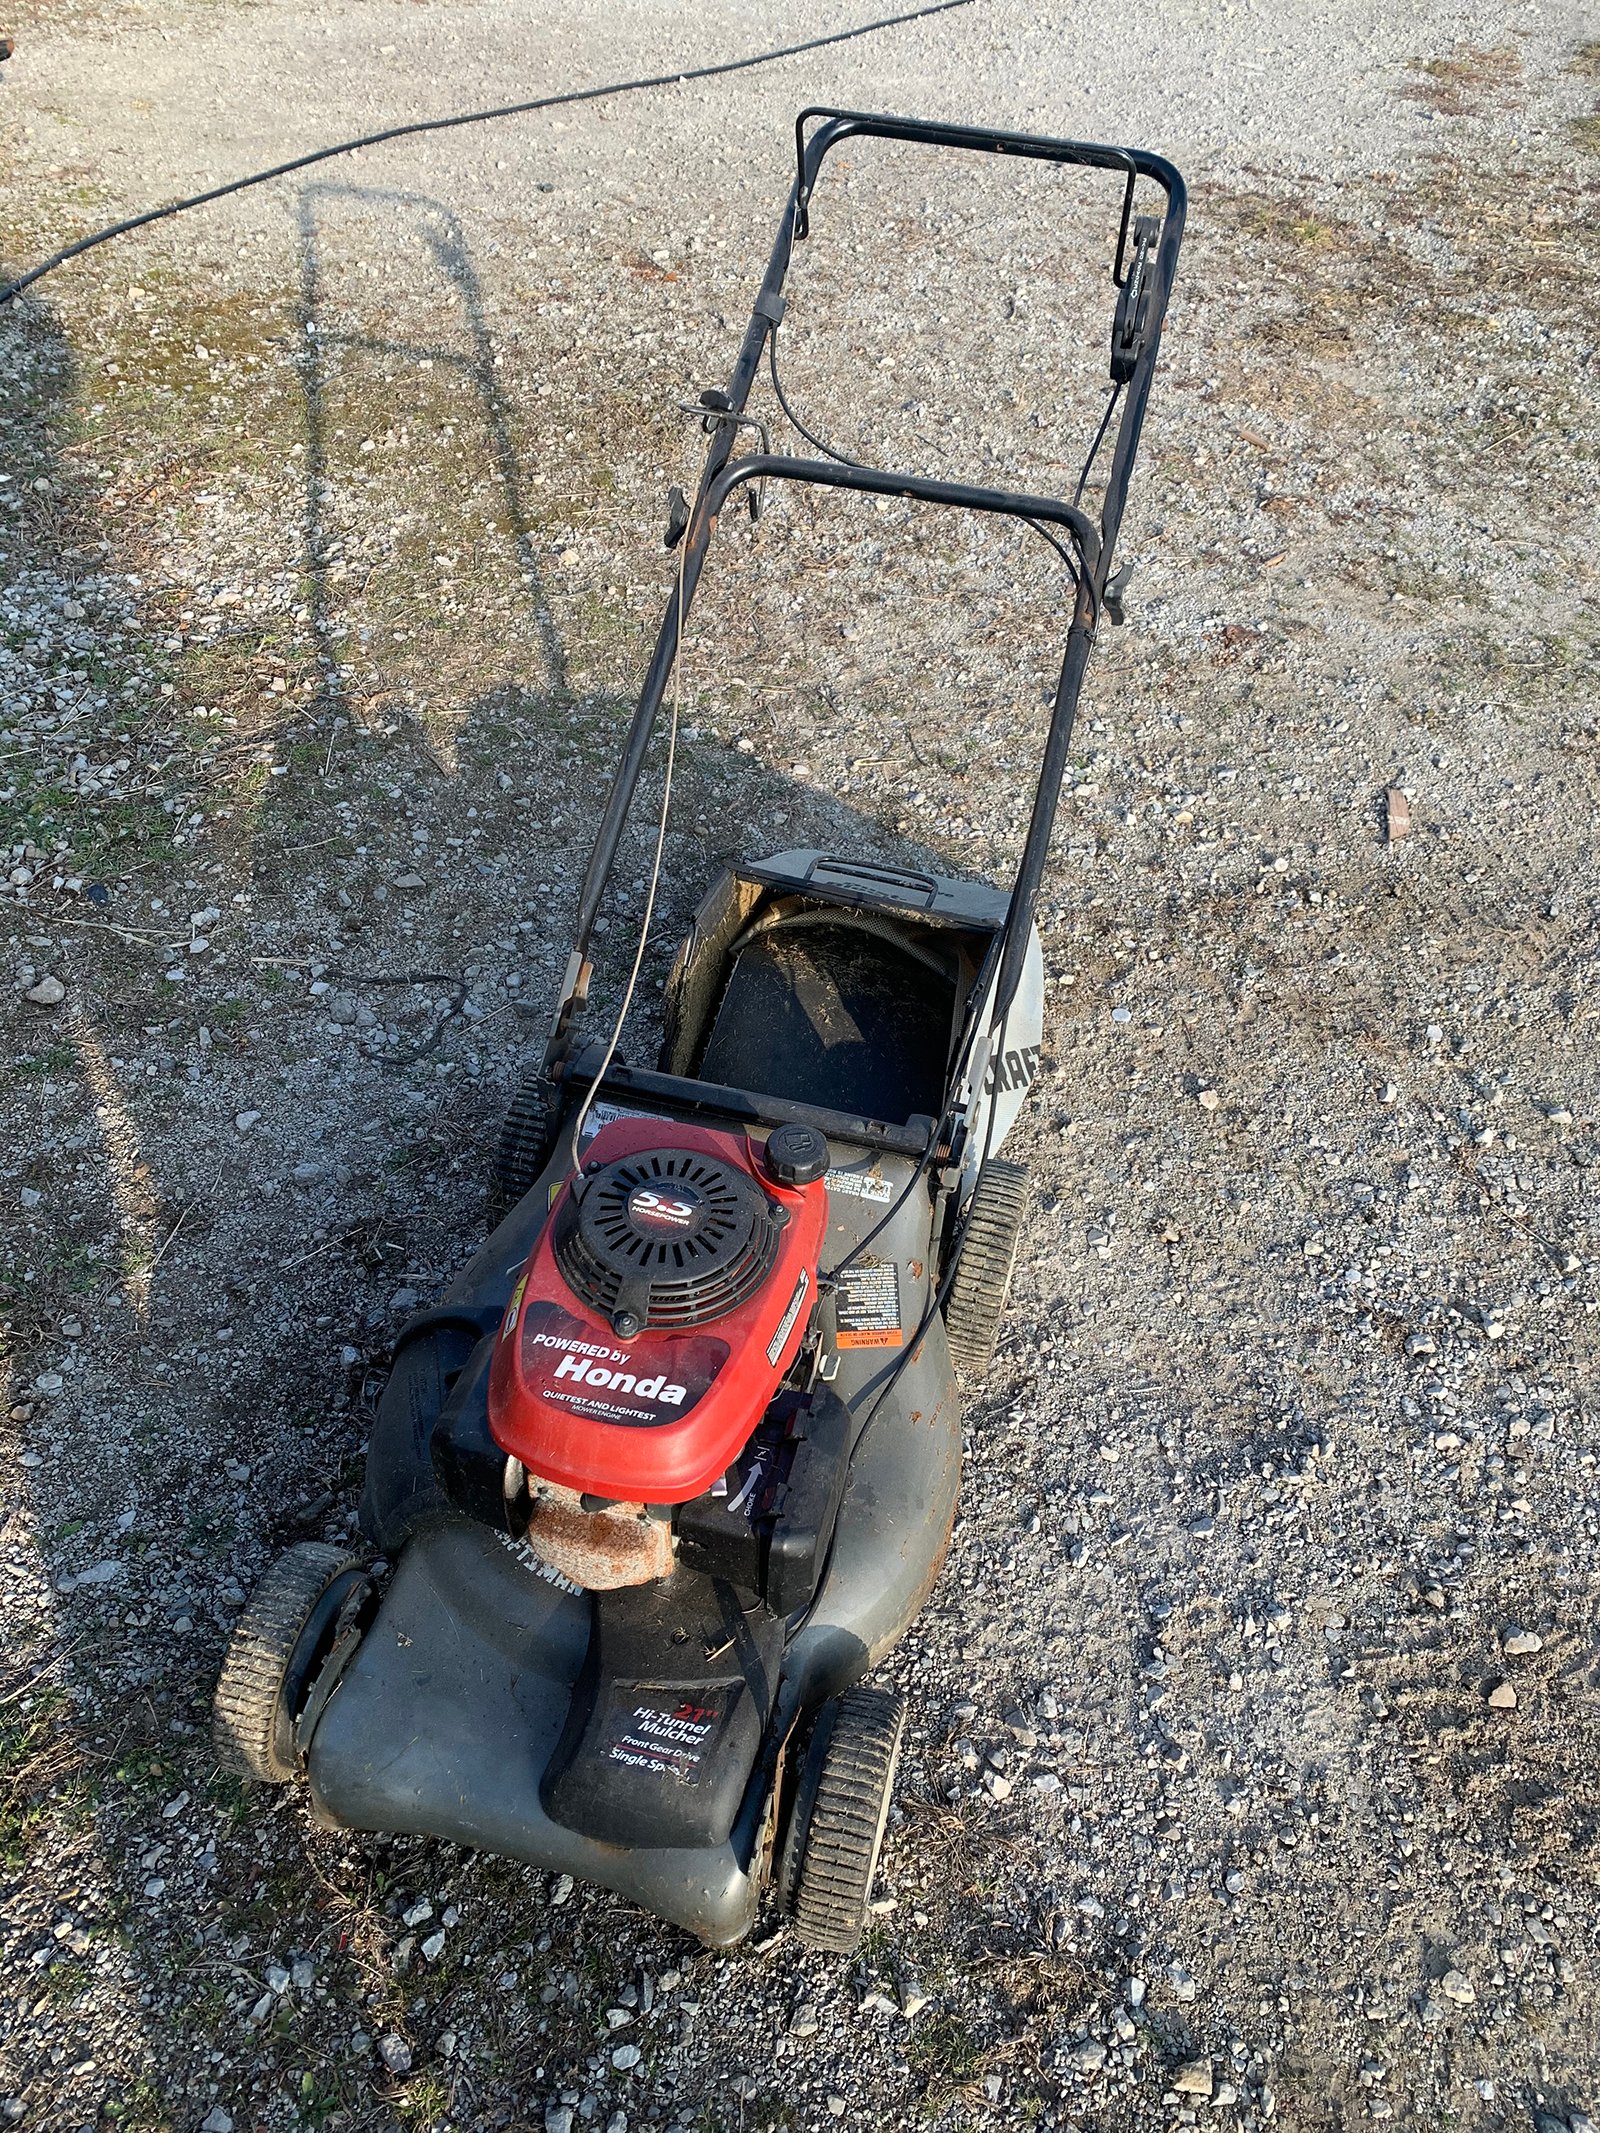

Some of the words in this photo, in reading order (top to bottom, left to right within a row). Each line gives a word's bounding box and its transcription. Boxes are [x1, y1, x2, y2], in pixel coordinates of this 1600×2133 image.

[632, 1191, 697, 1217] 5.5
[632, 1206, 691, 1226] HORSEPOWER
[532, 1333, 610, 1359] POWERED
[609, 1350, 631, 1365] by
[851, 1338, 881, 1346] WARNING
[553, 1355, 687, 1405] Honda
[542, 1390, 588, 1406] QUIETEST
[587, 1400, 610, 1411] AND
[609, 1404, 656, 1422] LIGHTEST
[571, 1404, 597, 1416] MOWER
[596, 1409, 622, 1421] ENGINE
[744, 1492, 756, 1517] CHOKE
[633, 1706, 711, 1735] Hi-Tunnel
[674, 1703, 718, 1724] 21"
[638, 1720, 704, 1747] Mulcher
[608, 1749, 649, 1766] Single
[621, 1735, 648, 1749] Front
[649, 1743, 674, 1756] Gear
[672, 1749, 701, 1763] Drive
